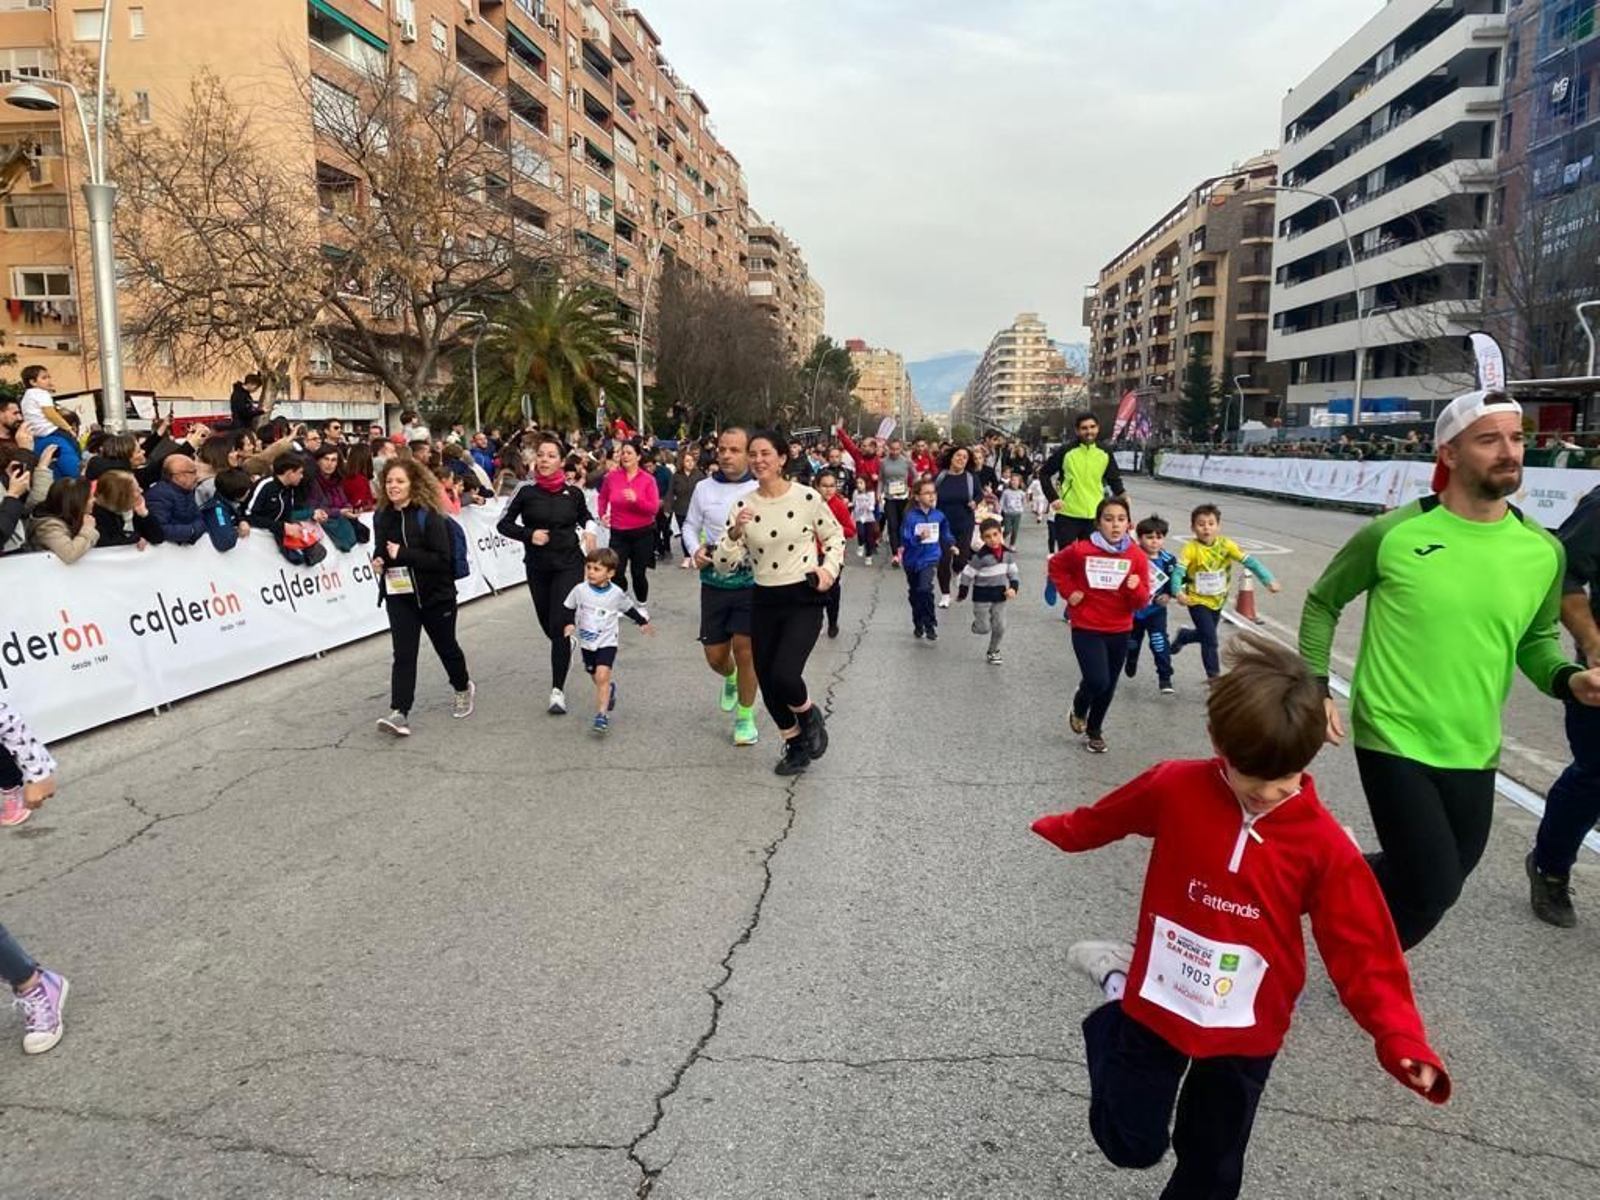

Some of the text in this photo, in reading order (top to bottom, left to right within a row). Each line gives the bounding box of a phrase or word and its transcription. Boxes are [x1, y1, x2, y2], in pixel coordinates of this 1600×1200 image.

[260, 563, 341, 612] calderón
[130, 581, 241, 644] calderón
[1202, 894, 1261, 920] attendis
[1166, 941, 1183, 955] SAN
[1176, 938, 1201, 954] NOCHE
[1201, 950, 1213, 960] DE
[1181, 962, 1212, 987] 1903
